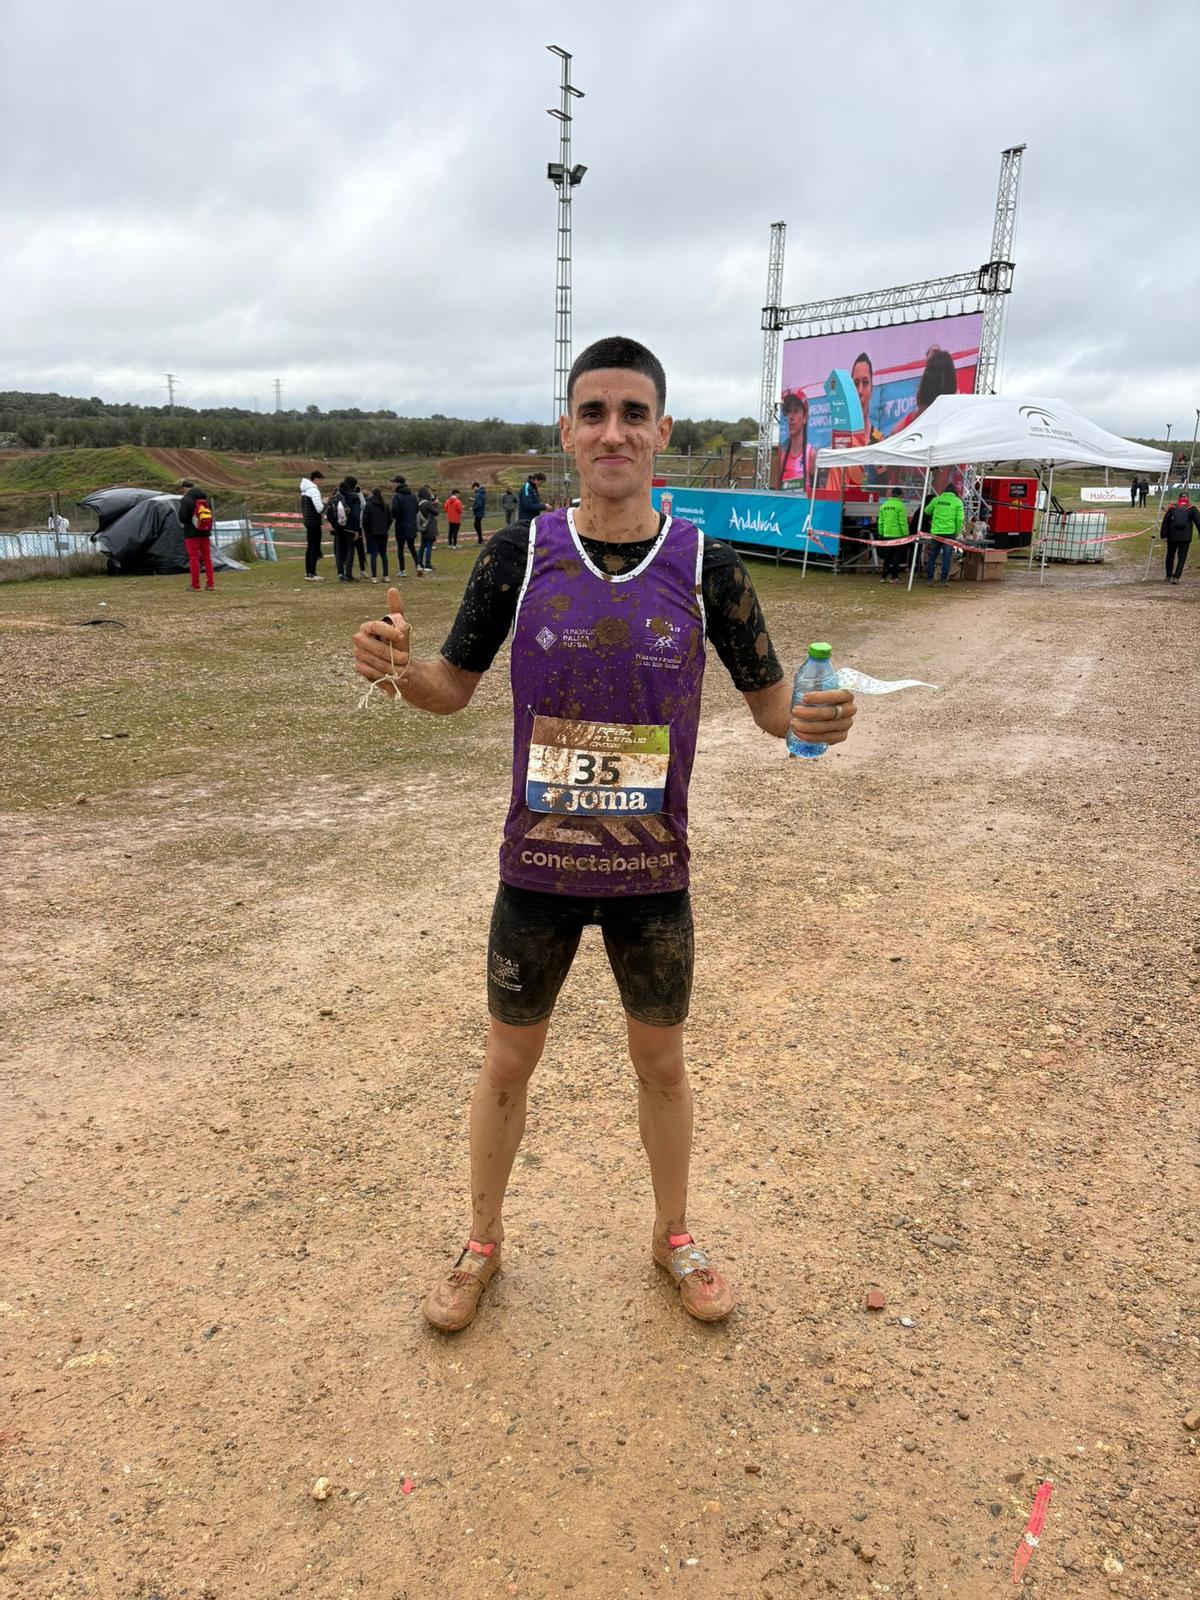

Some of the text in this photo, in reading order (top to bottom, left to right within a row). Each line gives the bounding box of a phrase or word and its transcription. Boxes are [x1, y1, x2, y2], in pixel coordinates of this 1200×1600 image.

[729, 507, 783, 537] Andalucía
[574, 754, 621, 785] 35
[520, 849, 678, 873] conectabalear
